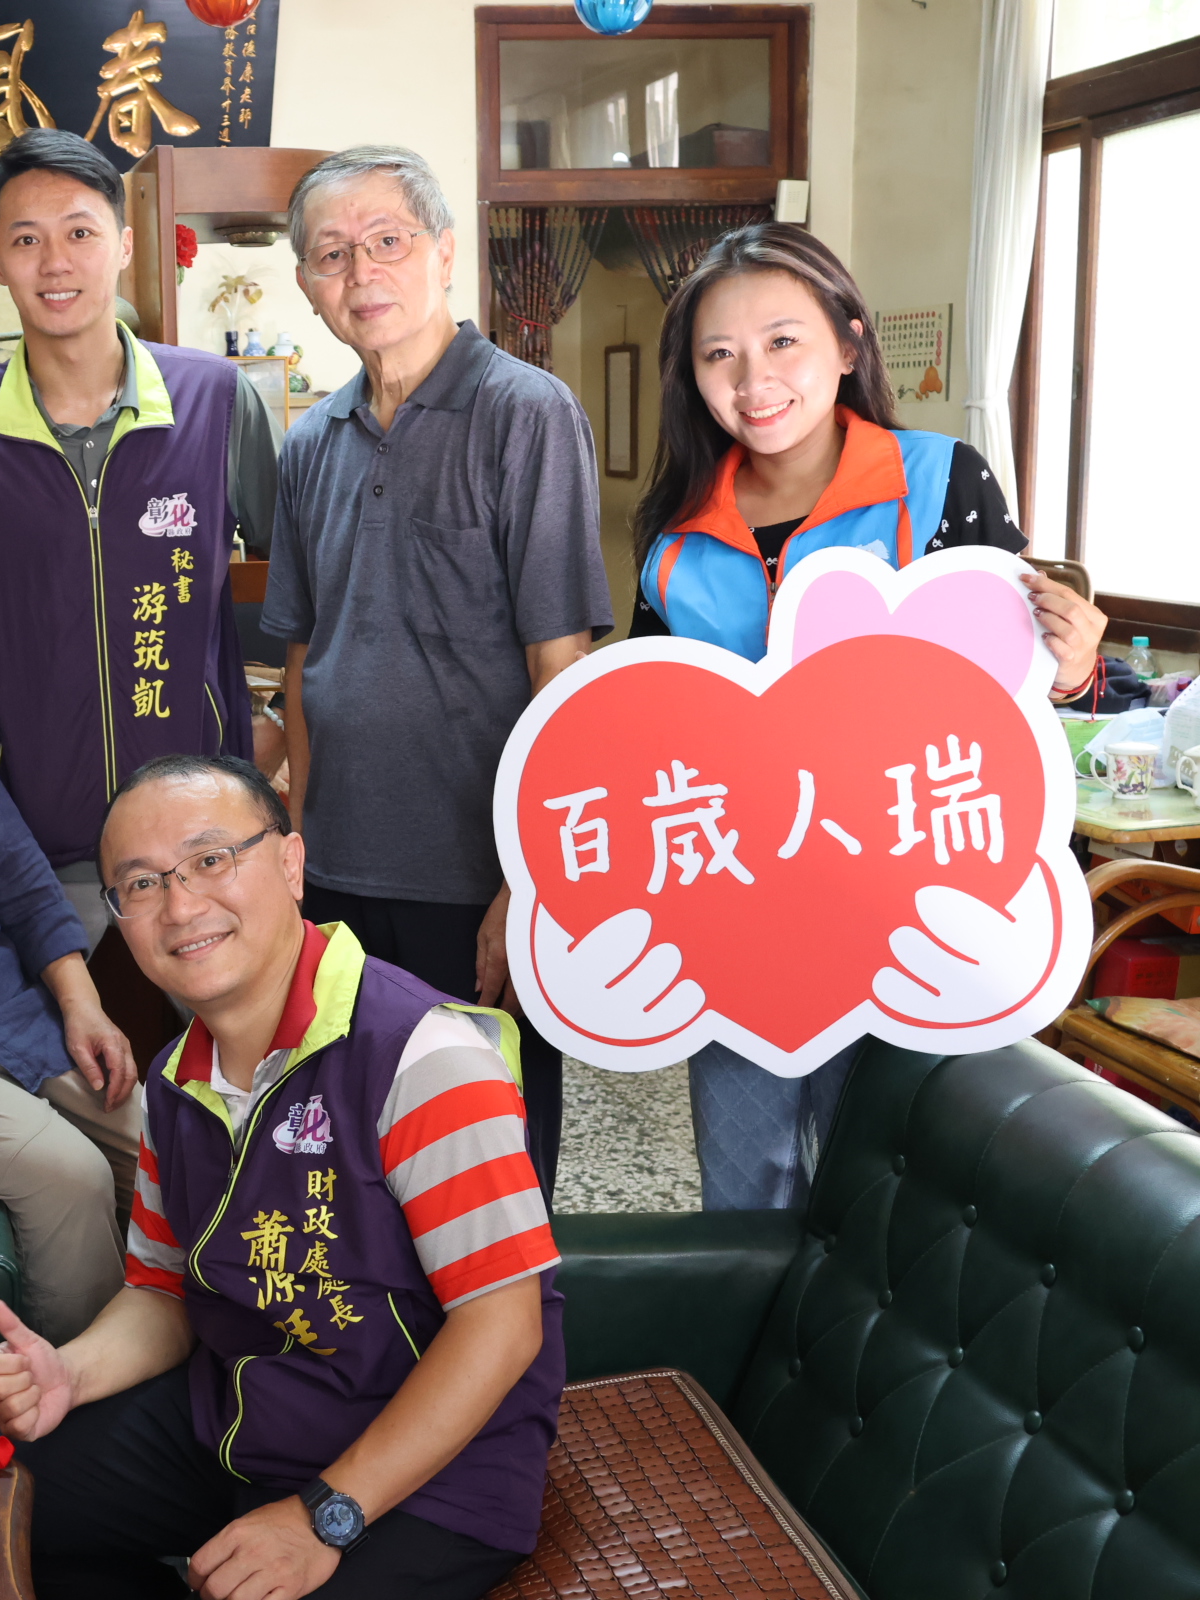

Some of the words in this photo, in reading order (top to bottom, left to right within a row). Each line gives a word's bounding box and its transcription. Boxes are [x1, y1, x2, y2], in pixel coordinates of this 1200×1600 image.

[148, 498, 191, 528] 彰化
[171, 547, 194, 604] 秘書
[131, 582, 171, 719] 游筑凱
[542, 733, 1005, 895] 百歲人瑞
